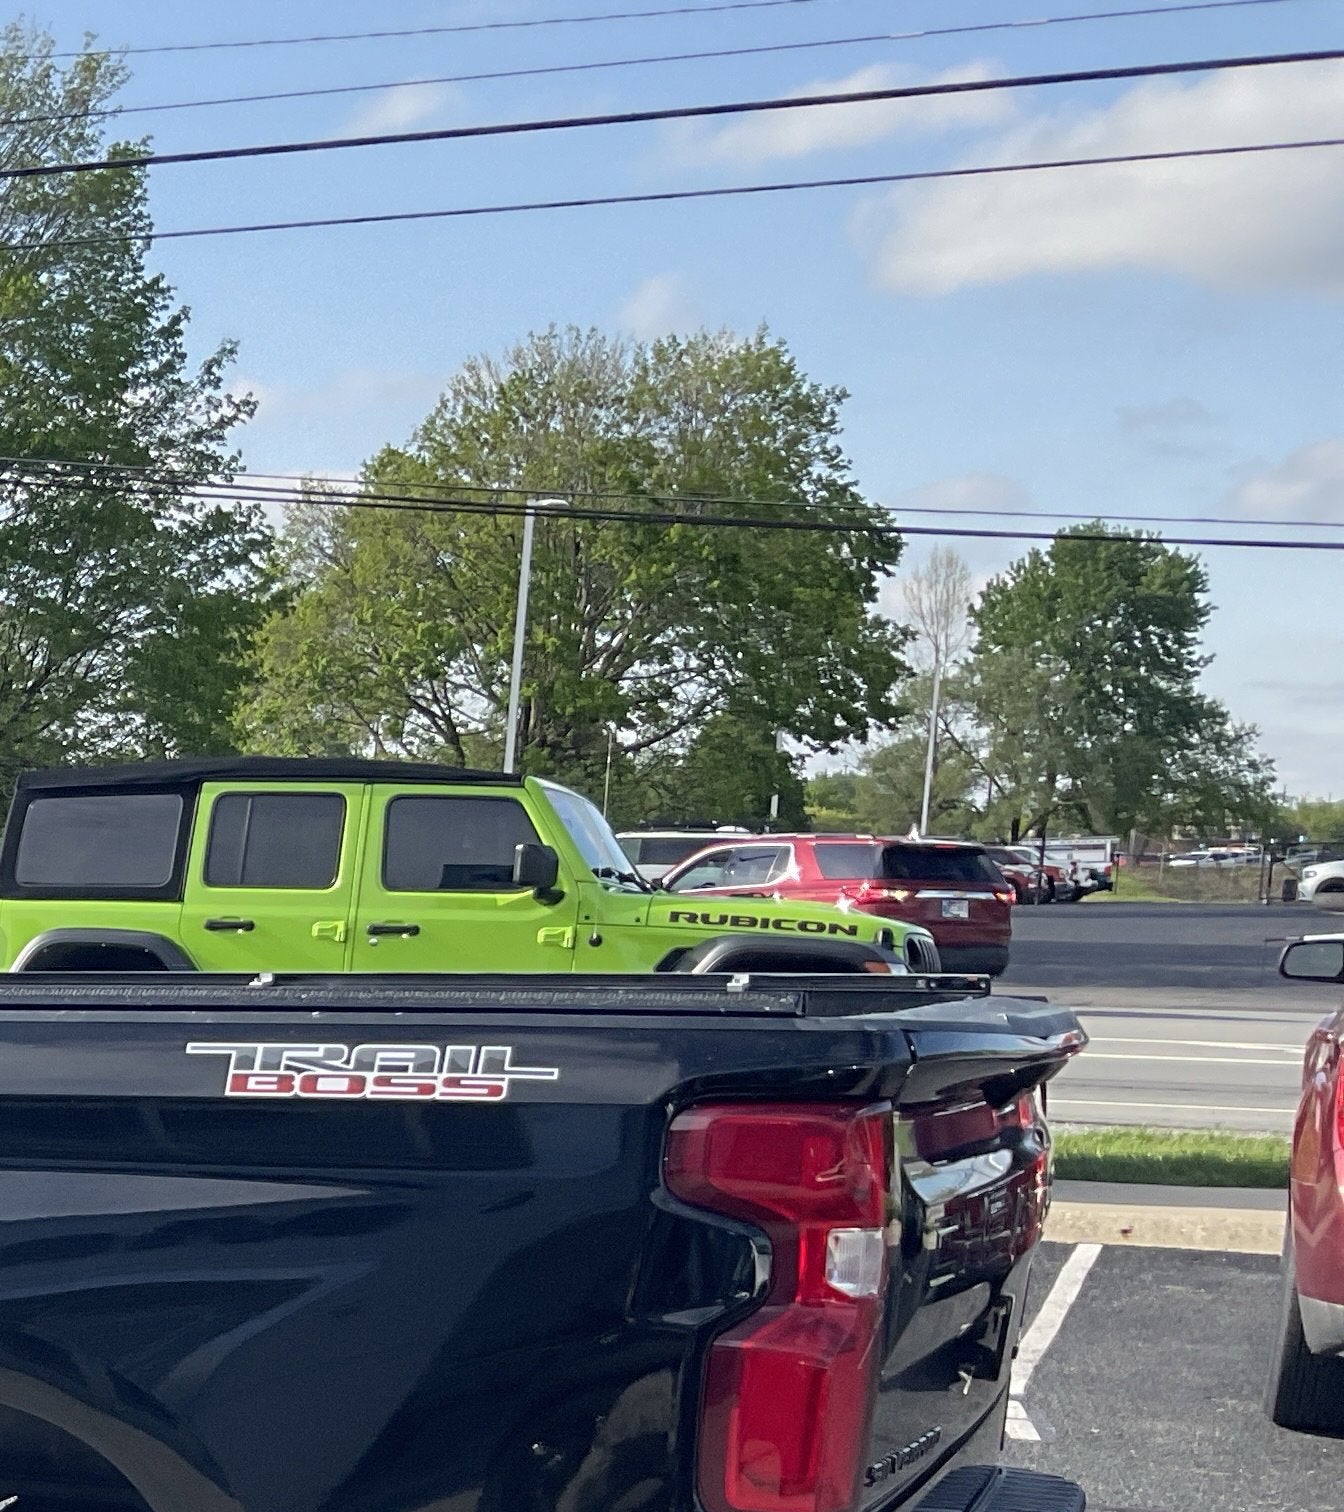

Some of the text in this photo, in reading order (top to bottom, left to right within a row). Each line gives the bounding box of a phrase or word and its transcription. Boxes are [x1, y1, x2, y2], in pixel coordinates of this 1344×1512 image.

[668, 910, 859, 936] RUBICON
[185, 1042, 559, 1080] TRAIL
[224, 1072, 510, 1101] BOSS
